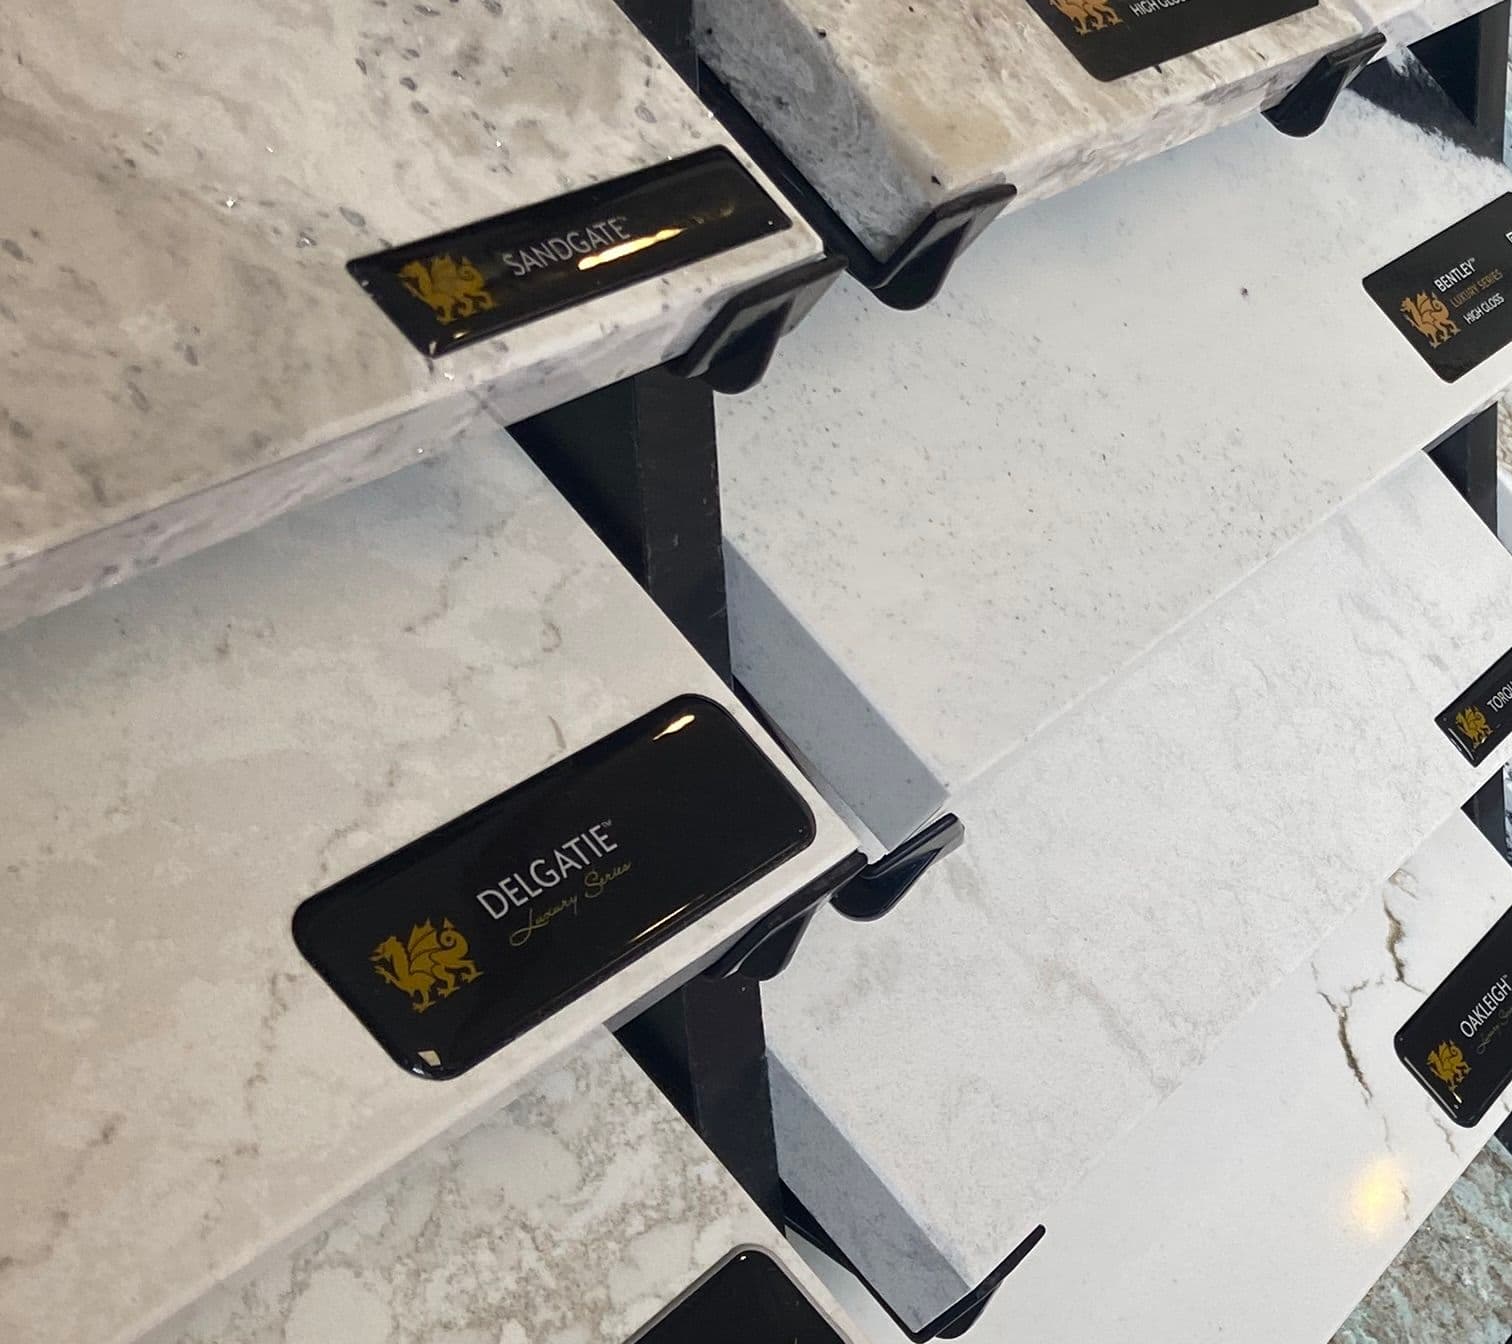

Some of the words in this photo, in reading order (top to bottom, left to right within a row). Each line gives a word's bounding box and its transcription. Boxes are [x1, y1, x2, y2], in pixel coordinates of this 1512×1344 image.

[1463, 304, 1485, 324] HIGH
[1481, 292, 1505, 314] GLOSS
[508, 892, 579, 948] Luxury
[583, 861, 633, 900] Series
